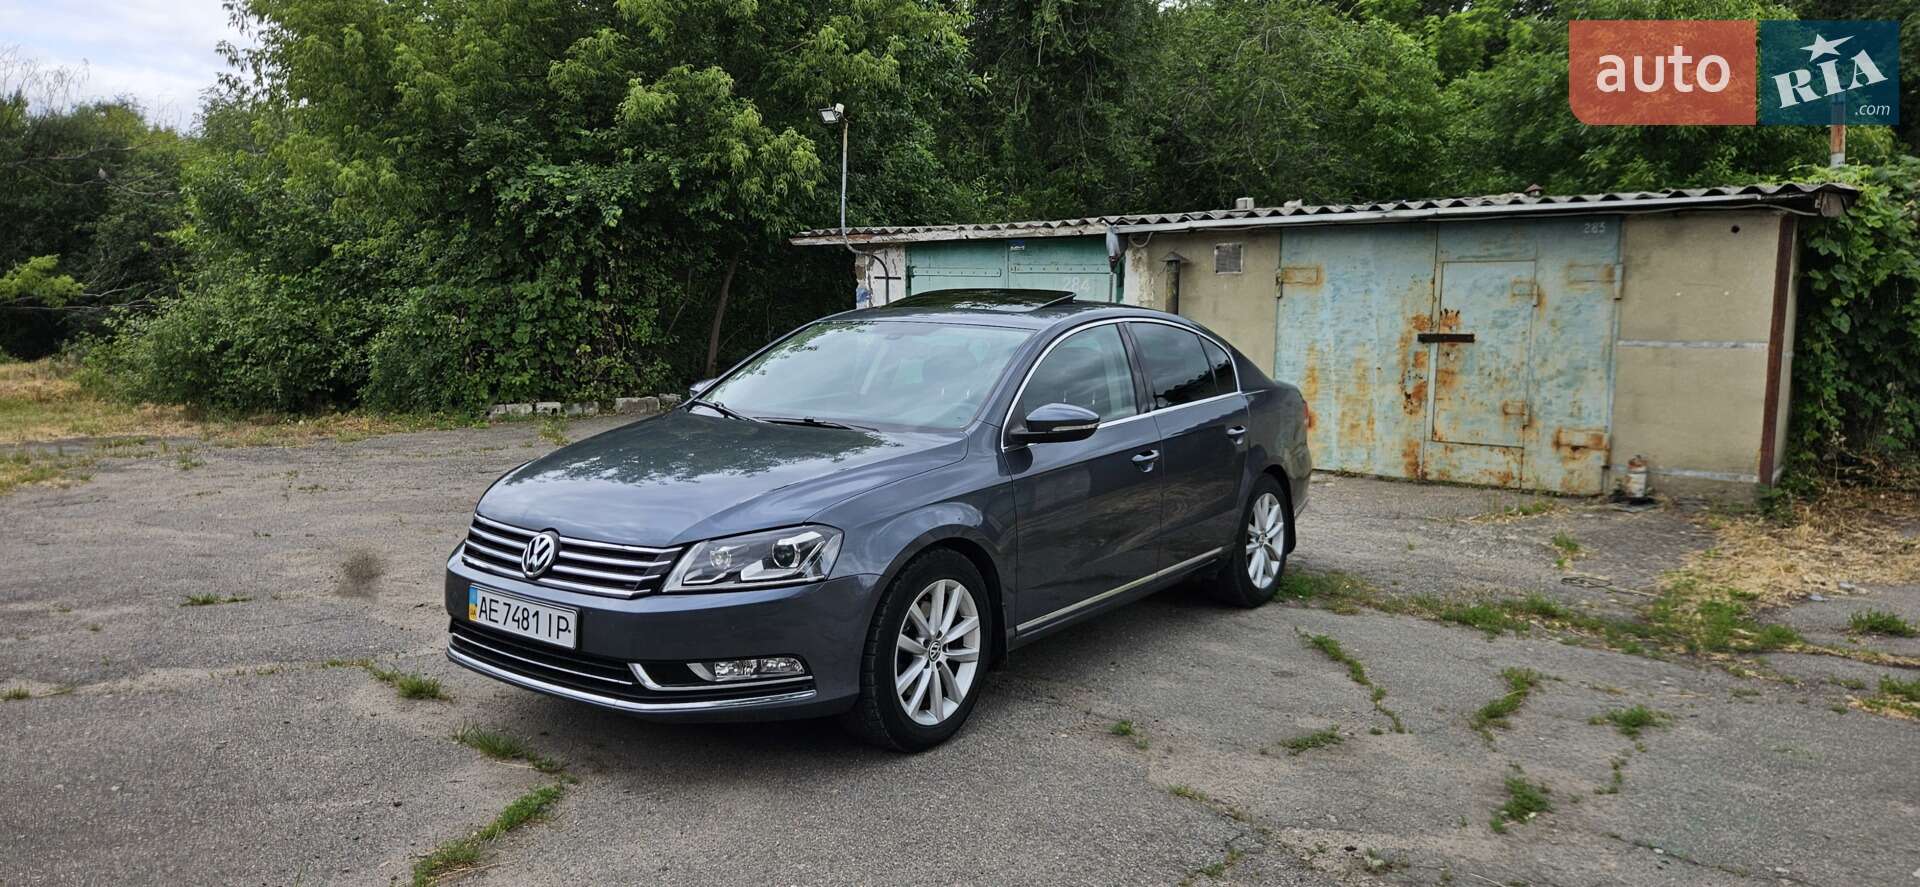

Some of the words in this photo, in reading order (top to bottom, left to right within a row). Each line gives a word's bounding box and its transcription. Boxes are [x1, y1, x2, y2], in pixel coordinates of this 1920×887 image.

[479, 596, 500, 623] AE
[503, 602, 540, 634] 7481
[548, 612, 571, 639] IP
